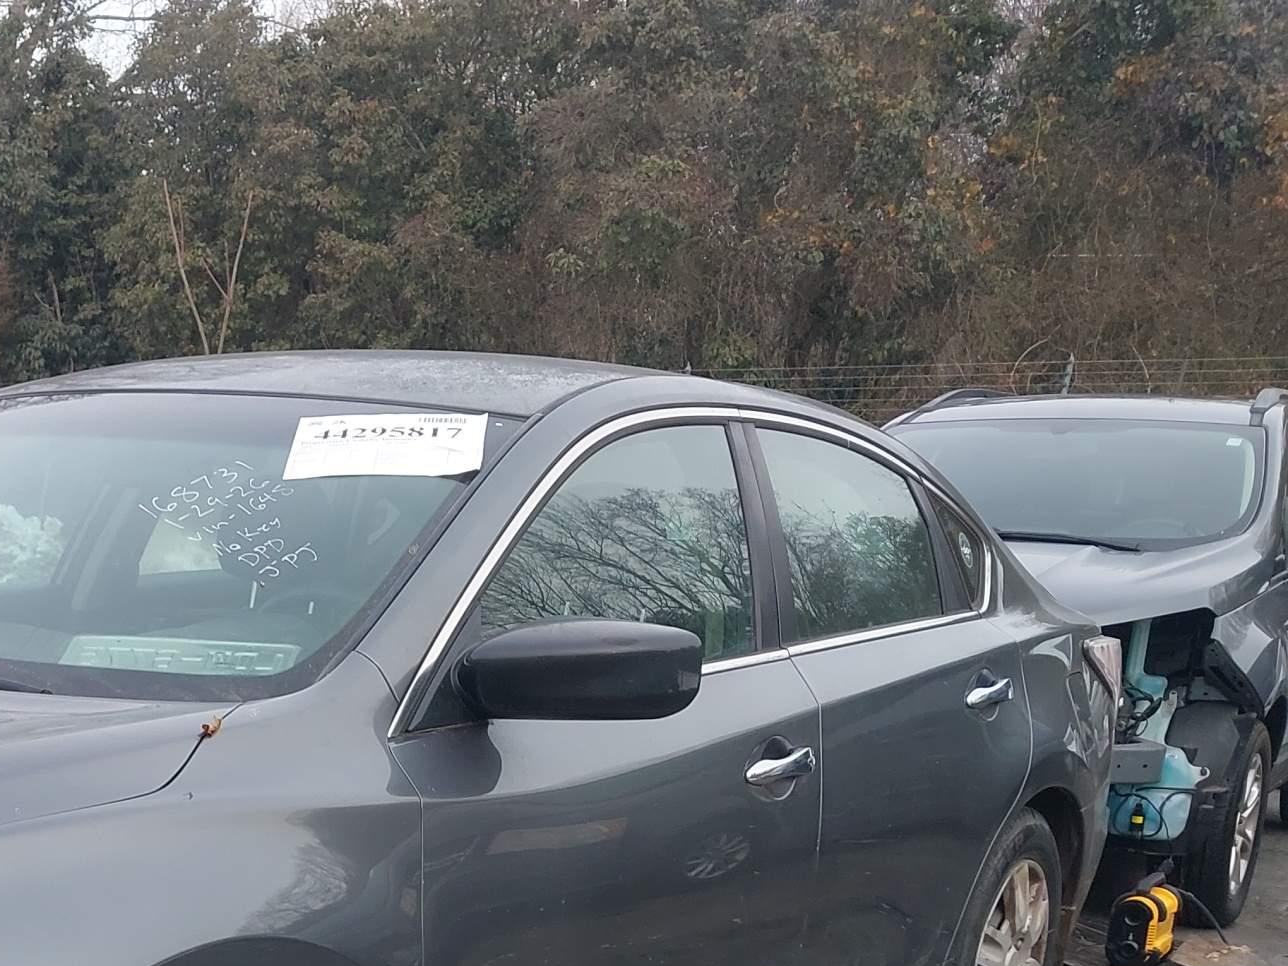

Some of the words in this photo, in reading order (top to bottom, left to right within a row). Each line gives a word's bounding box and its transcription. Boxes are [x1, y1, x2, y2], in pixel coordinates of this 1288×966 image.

[314, 426, 464, 440] 44295817
[138, 460, 254, 519] 168731
[164, 478, 270, 529] 1-29-26
